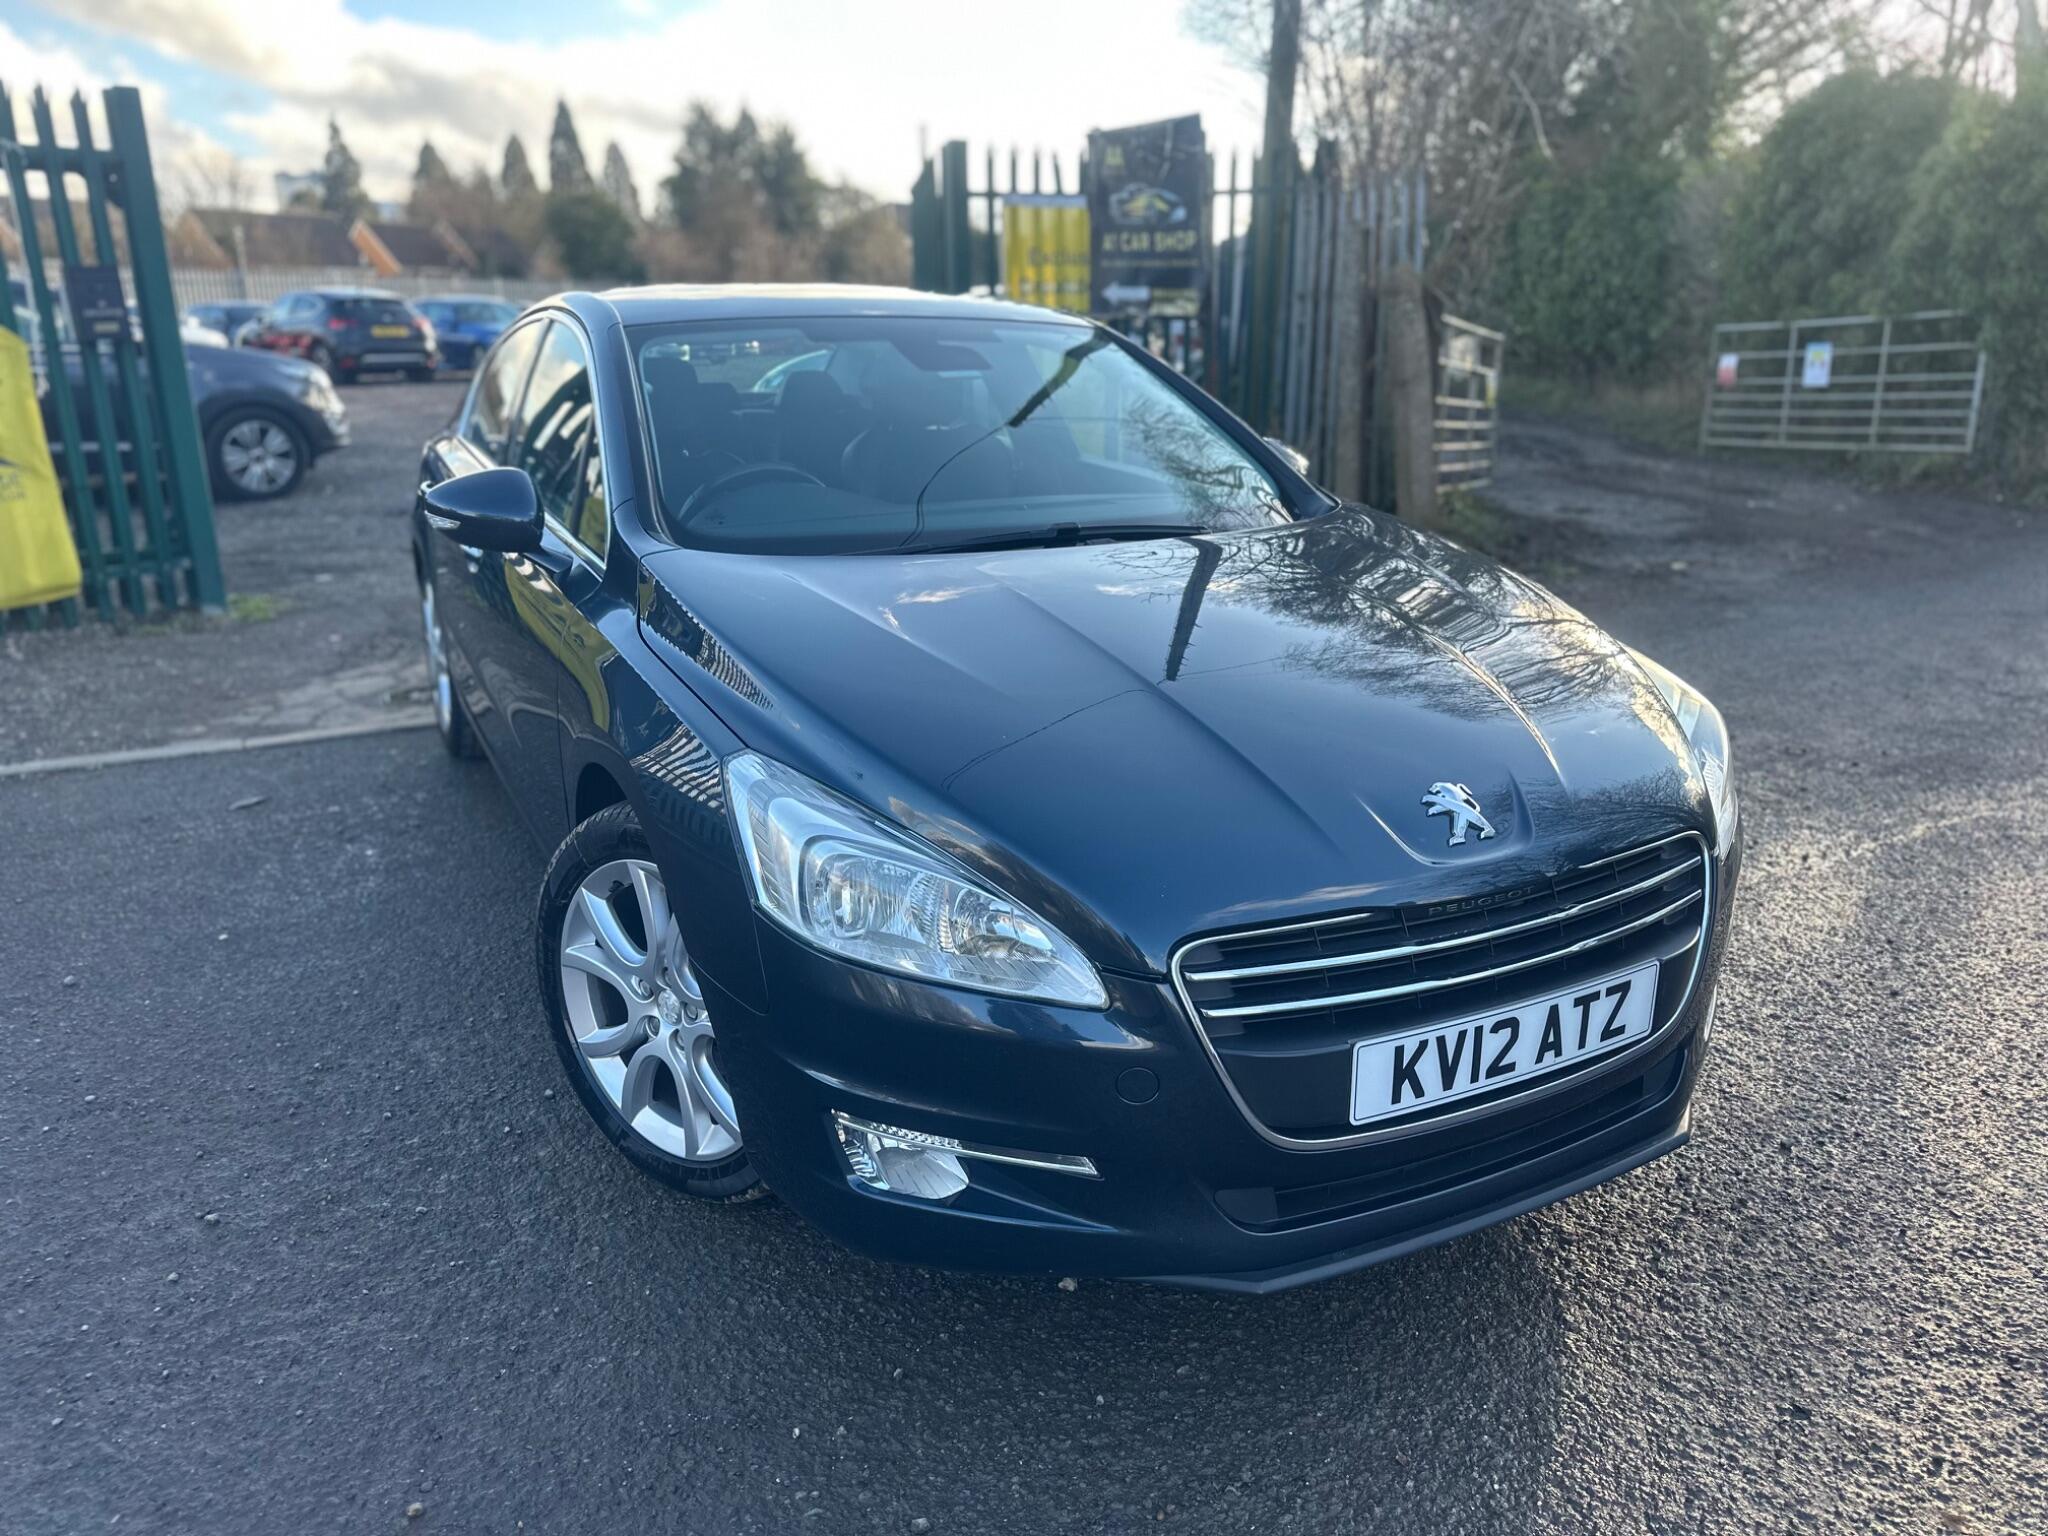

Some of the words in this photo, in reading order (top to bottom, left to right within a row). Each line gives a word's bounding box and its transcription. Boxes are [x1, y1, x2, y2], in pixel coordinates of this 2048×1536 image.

[1120, 230, 1150, 252] CAR
[1154, 229, 1197, 252] SHOP
[1428, 887, 1535, 917] PEUGEOT
[1391, 1016, 1520, 1105] KV12
[1534, 980, 1632, 1065] ATZ
